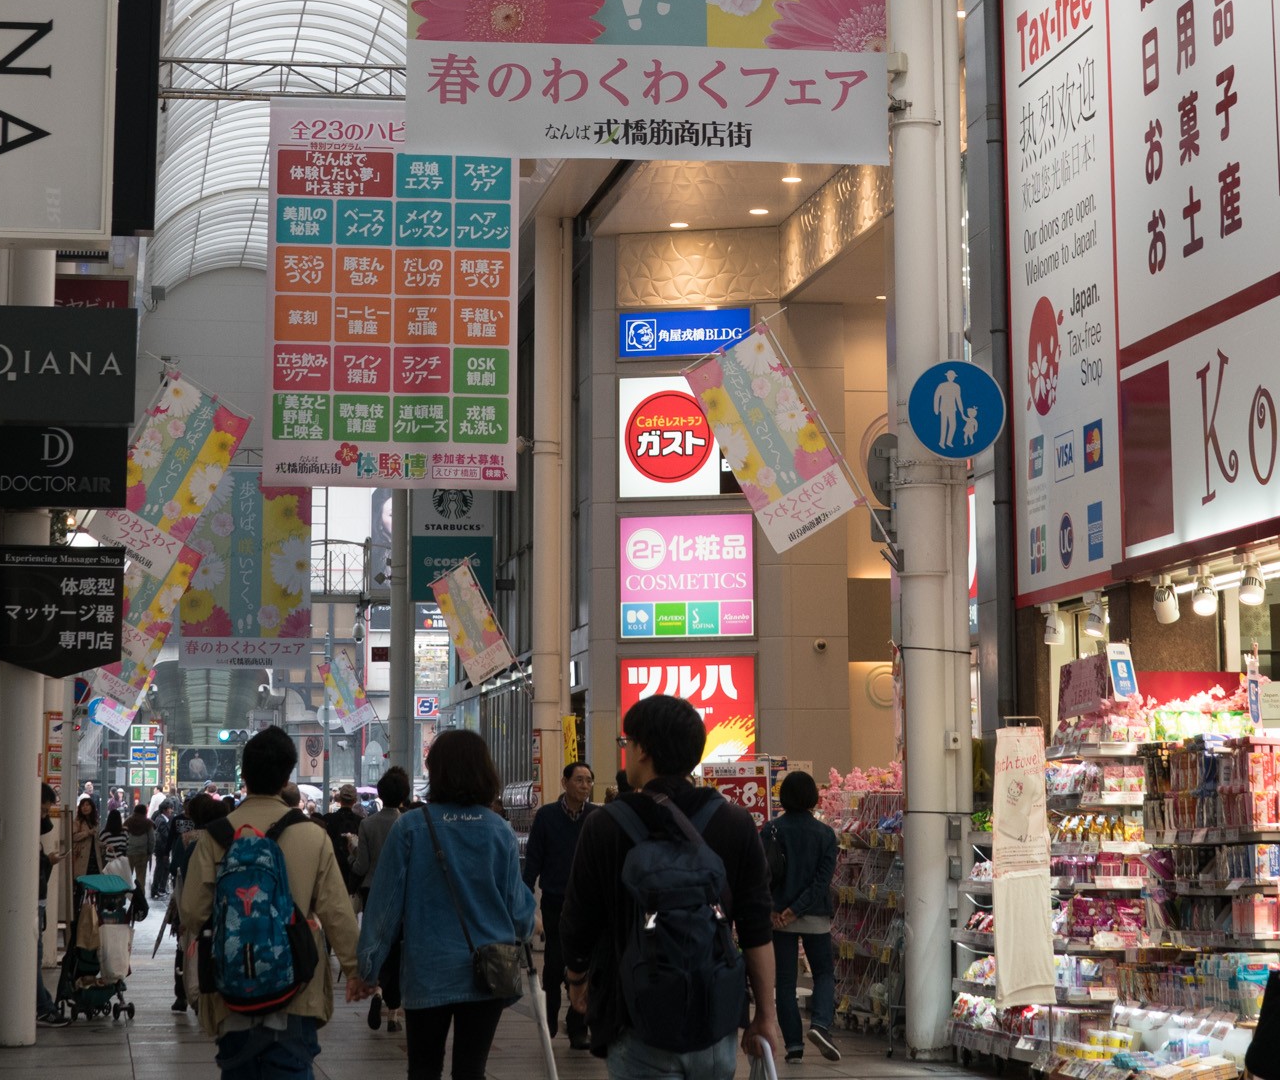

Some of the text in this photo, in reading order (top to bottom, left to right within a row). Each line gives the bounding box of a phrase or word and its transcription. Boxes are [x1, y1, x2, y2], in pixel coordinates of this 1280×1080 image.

[427, 52, 869, 112] 春のわくわくフェア
[1020, 56, 1097, 173] 热烈欢迎
[1144, 64, 1238, 185] お菓子
[410, 163, 439, 176] 母娘
[464, 164, 503, 176] スキン
[405, 178, 444, 190] エステ
[471, 179, 495, 191] ケア
[283, 207, 327, 221] 美肌の
[344, 210, 385, 221] ベース
[407, 211, 442, 223] メイク
[470, 212, 496, 225] ヘア
[1147, 161, 1243, 276] お土産
[290, 222, 319, 236] 秘訣
[346, 224, 383, 236] メイク
[400, 226, 448, 238] レッスン
[457, 226, 509, 239] アレンジ
[1024, 206, 1074, 254] Our doors are
[1025, 219, 1097, 287] Welcome Japan!
[284, 255, 324, 270] 天ぷら
[344, 257, 384, 271] 豚まん
[404, 258, 443, 271] だしの
[461, 260, 504, 274] 和菓子
[286, 270, 322, 283] づくり
[350, 272, 378, 285] 包み
[405, 273, 441, 287] とり方
[465, 275, 500, 288] づくり
[1070, 281, 1100, 317] Japan.
[289, 311, 318, 325] 篆刻
[336, 306, 389, 318] コーヒー
[460, 308, 503, 322] 手縫い
[348, 321, 378, 334] 講座
[408, 322, 437, 336] 知識
[467, 323, 496, 337] 講座
[1067, 322, 1102, 357] Tax-free
[277, 353, 328, 367] 立ち飲み
[344, 355, 381, 368] ワイン
[402, 356, 441, 369] ランチ
[467, 357, 495, 370] OSK
[284, 369, 321, 381] ツアー
[347, 370, 377, 384] 探訪
[402, 371, 441, 384] ツアー
[467, 371, 495, 386] 観劇
[1080, 356, 1103, 387] Shop
[340, 404, 384, 418] 歌舞伎
[400, 405, 443, 420] 道頓堀
[466, 406, 495, 420] 戎橋
[279, 425, 323, 439] 上映会
[347, 419, 376, 433] 講座
[395, 420, 448, 434] クルーズ
[459, 421, 502, 435] 丸洗い
[636, 430, 705, 457] ガスト
[1056, 442, 1073, 468] VISA
[275, 463, 341, 475] 戎橋筋商店街
[1060, 527, 1073, 553] UC
[632, 534, 746, 561] 2F 化粧品
[1031, 541, 1046, 559] JCB
[5, 553, 120, 565] Experiencing Massager Shop
[60, 577, 115, 597] 体感型
[626, 572, 746, 590] COSMETICS
[5, 604, 115, 623] マッサージ器
[59, 631, 113, 650] 専門店
[185, 640, 305, 655] 春のわくわくフェア
[628, 665, 738, 700] ツルハ
